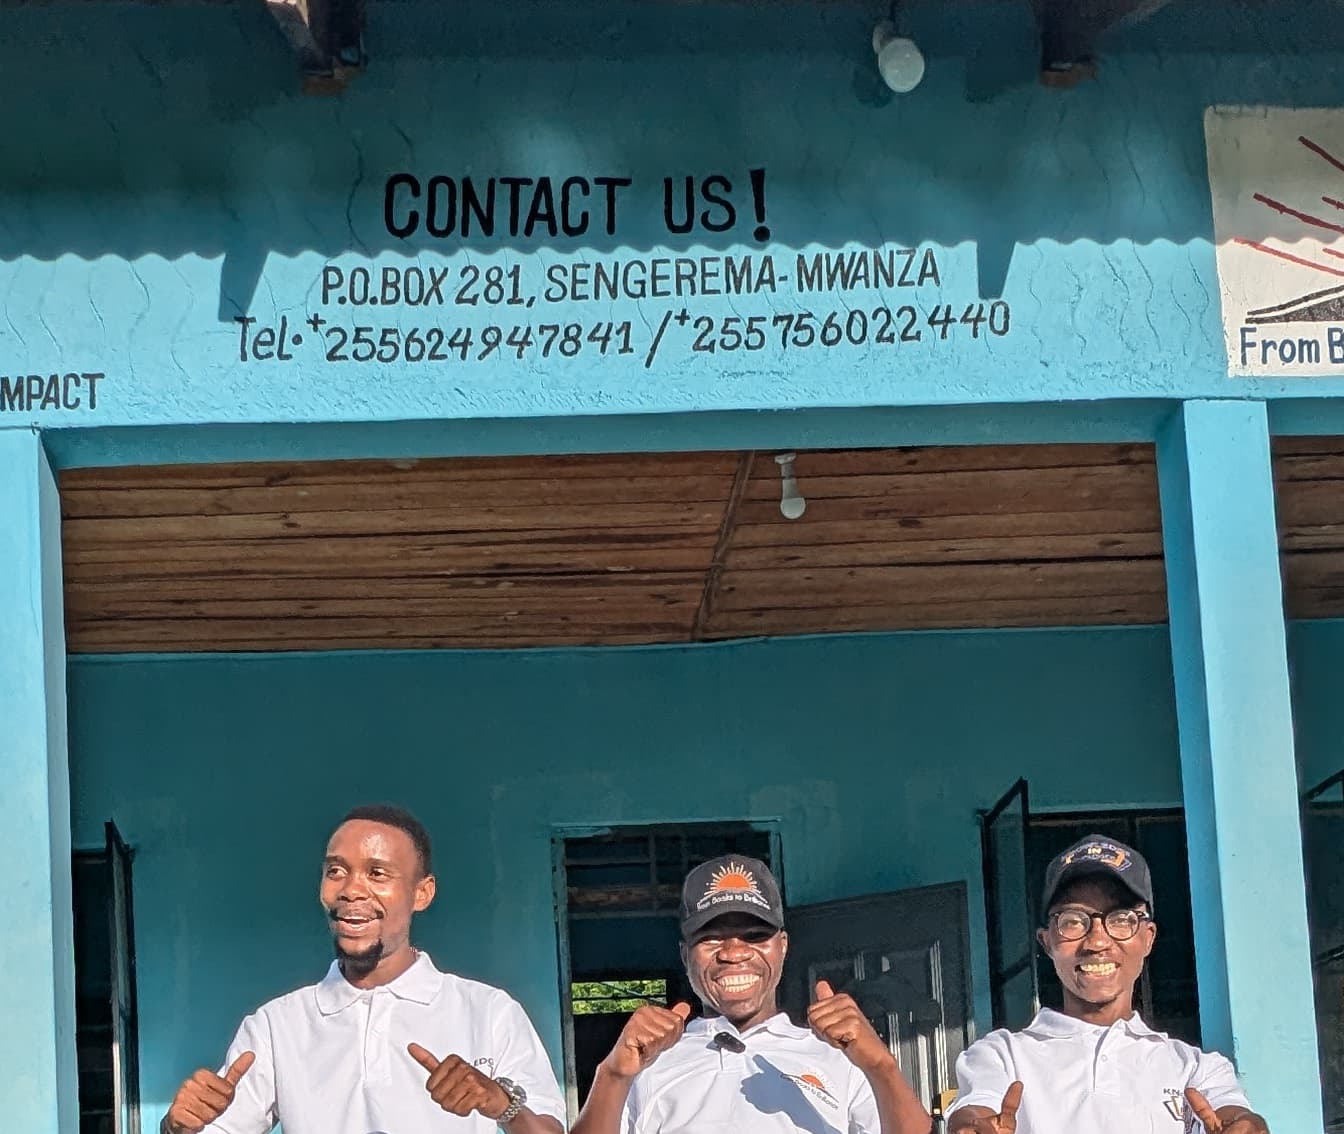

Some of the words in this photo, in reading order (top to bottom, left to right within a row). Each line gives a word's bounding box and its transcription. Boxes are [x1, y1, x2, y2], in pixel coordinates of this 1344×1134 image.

[385, 173, 633, 241] CONTACT
[663, 167, 772, 244] US!
[454, 263, 537, 310] 281,
[1239, 326, 1321, 368] From
